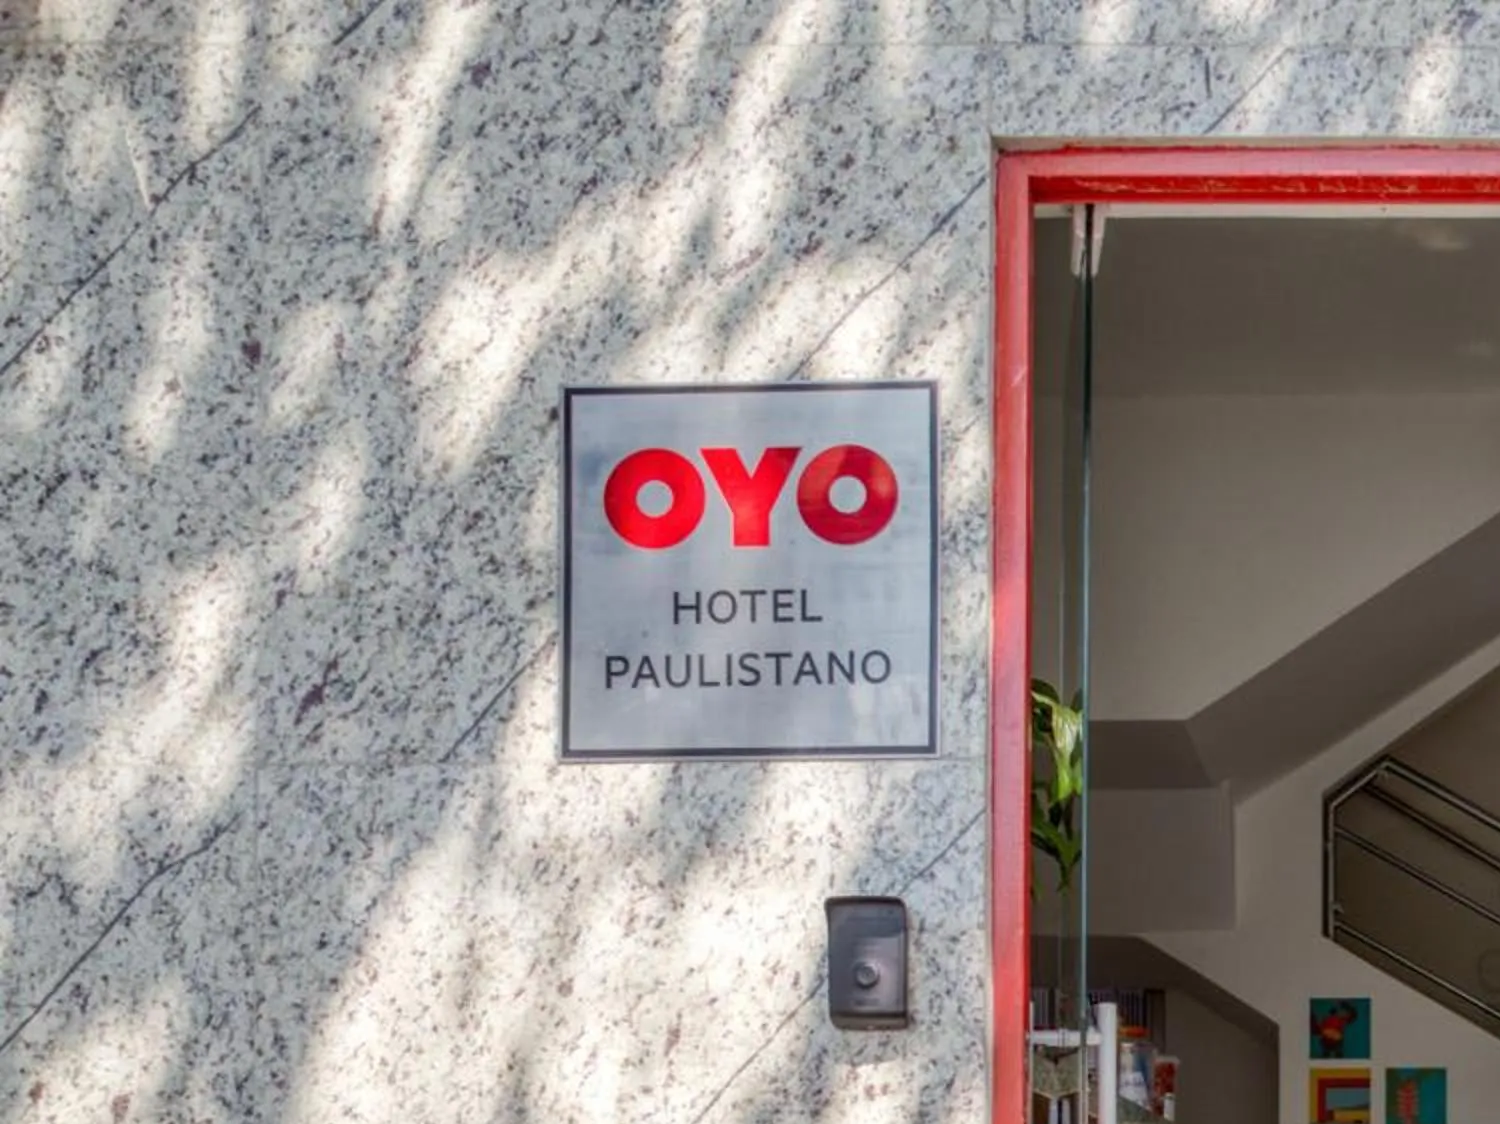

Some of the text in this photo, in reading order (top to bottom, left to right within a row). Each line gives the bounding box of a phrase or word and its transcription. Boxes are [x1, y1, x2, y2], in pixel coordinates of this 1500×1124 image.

[604, 444, 898, 549] OYO
[673, 589, 823, 625] HOTEL
[605, 650, 892, 689] PAULISTANO
